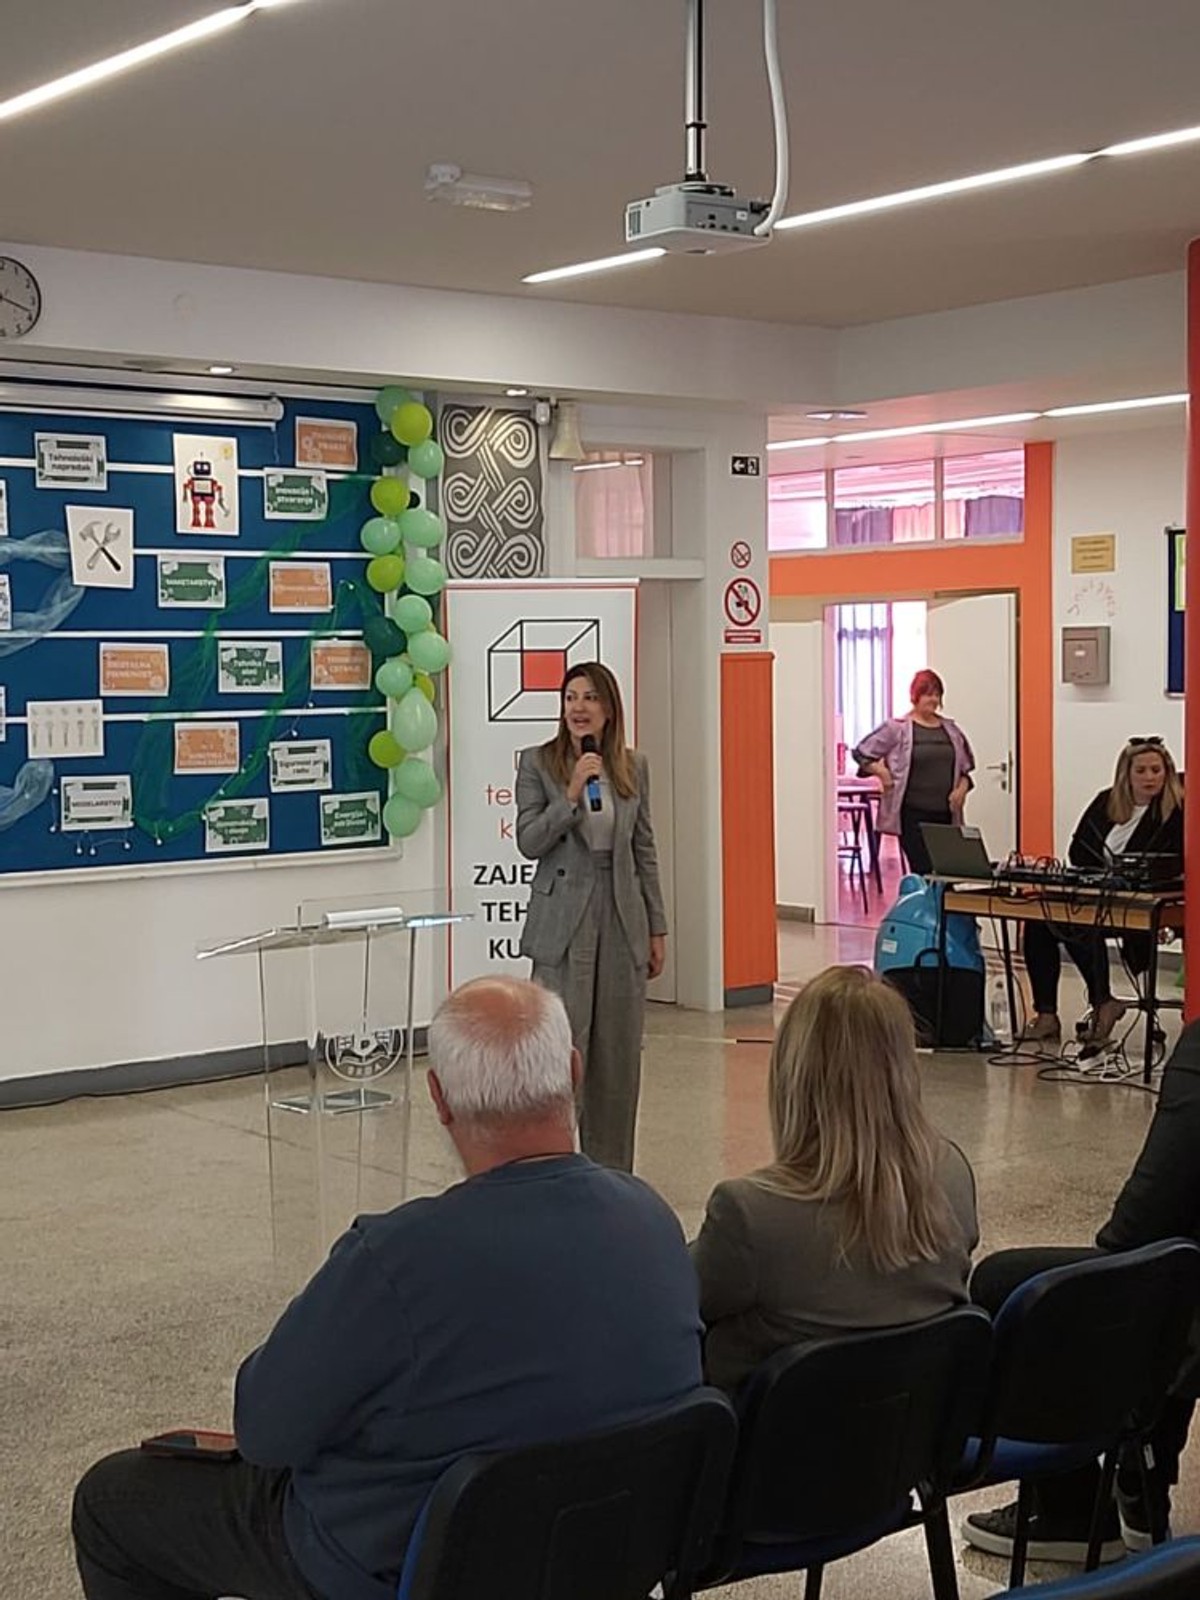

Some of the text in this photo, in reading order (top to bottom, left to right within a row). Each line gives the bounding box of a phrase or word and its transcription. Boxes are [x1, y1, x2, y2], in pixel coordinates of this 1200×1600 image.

[49, 453, 93, 463] Tehnološki
[52, 463, 91, 472] napredak
[279, 760, 311, 769] Sigurnost
[72, 799, 121, 808] MODELARSTVO
